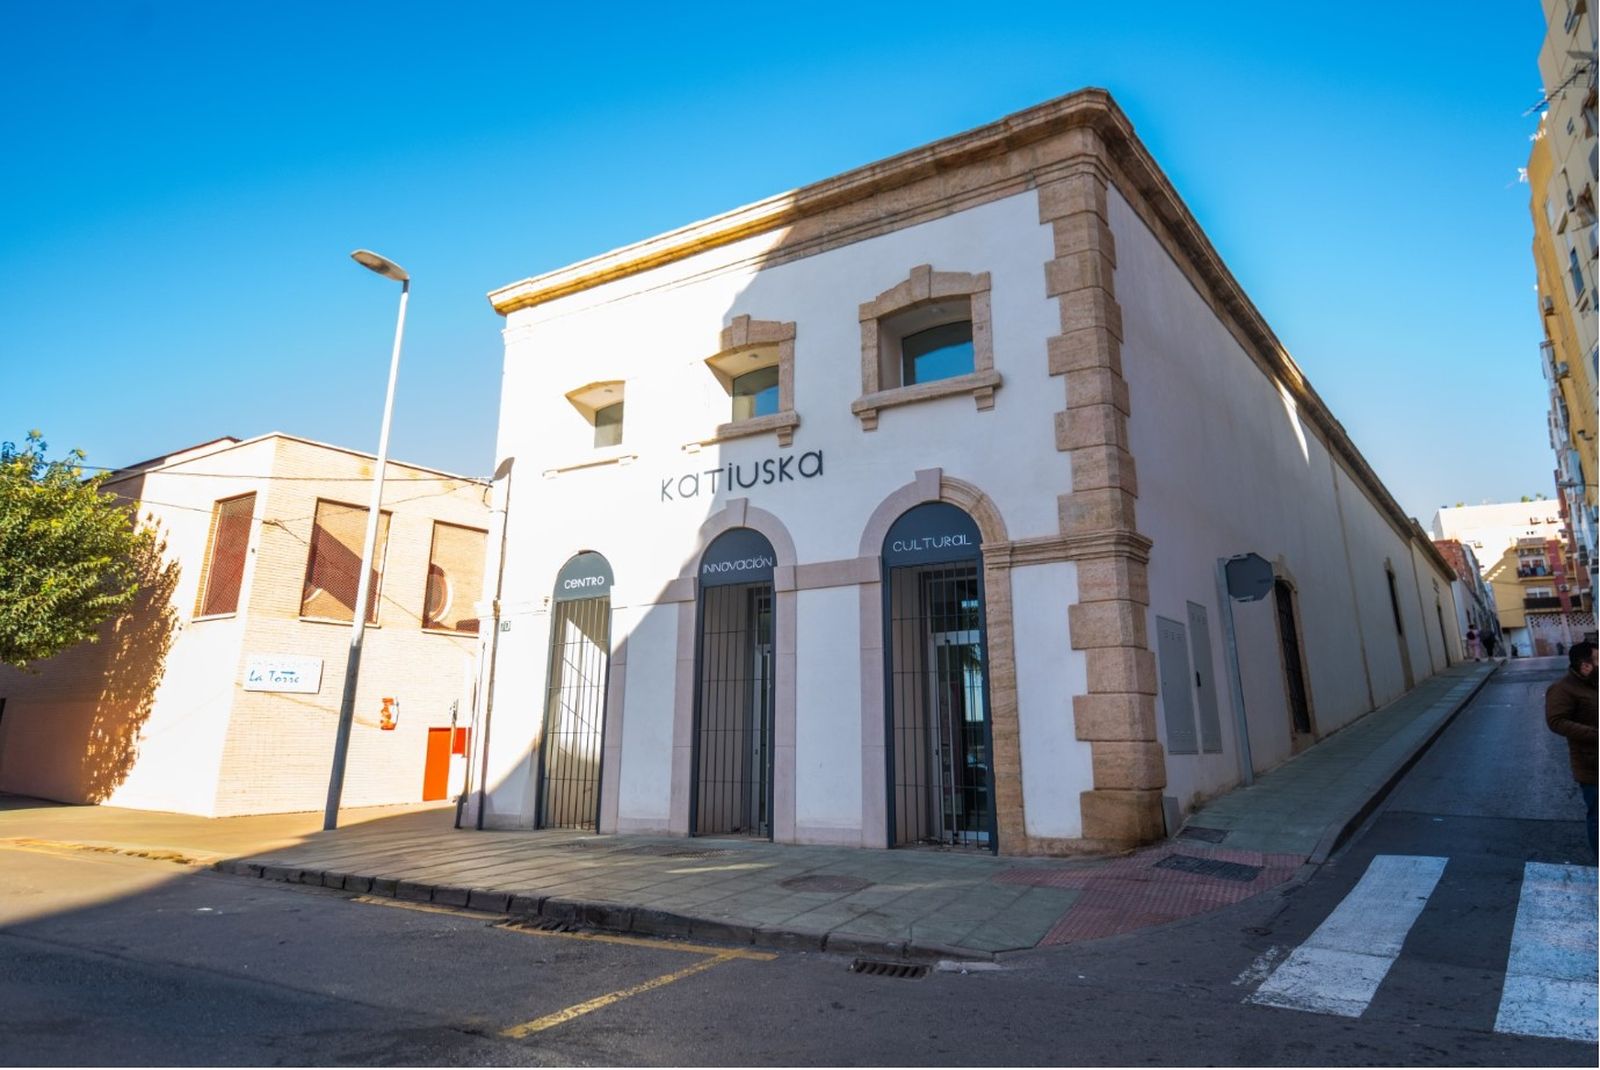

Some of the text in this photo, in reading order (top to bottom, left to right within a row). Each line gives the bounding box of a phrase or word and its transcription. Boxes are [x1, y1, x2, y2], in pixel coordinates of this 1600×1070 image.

[661, 449, 824, 502] KaTiUSKa
[892, 533, 973, 552] CULTURaL
[564, 575, 605, 589] CeNTRO
[248, 669, 263, 682] La
